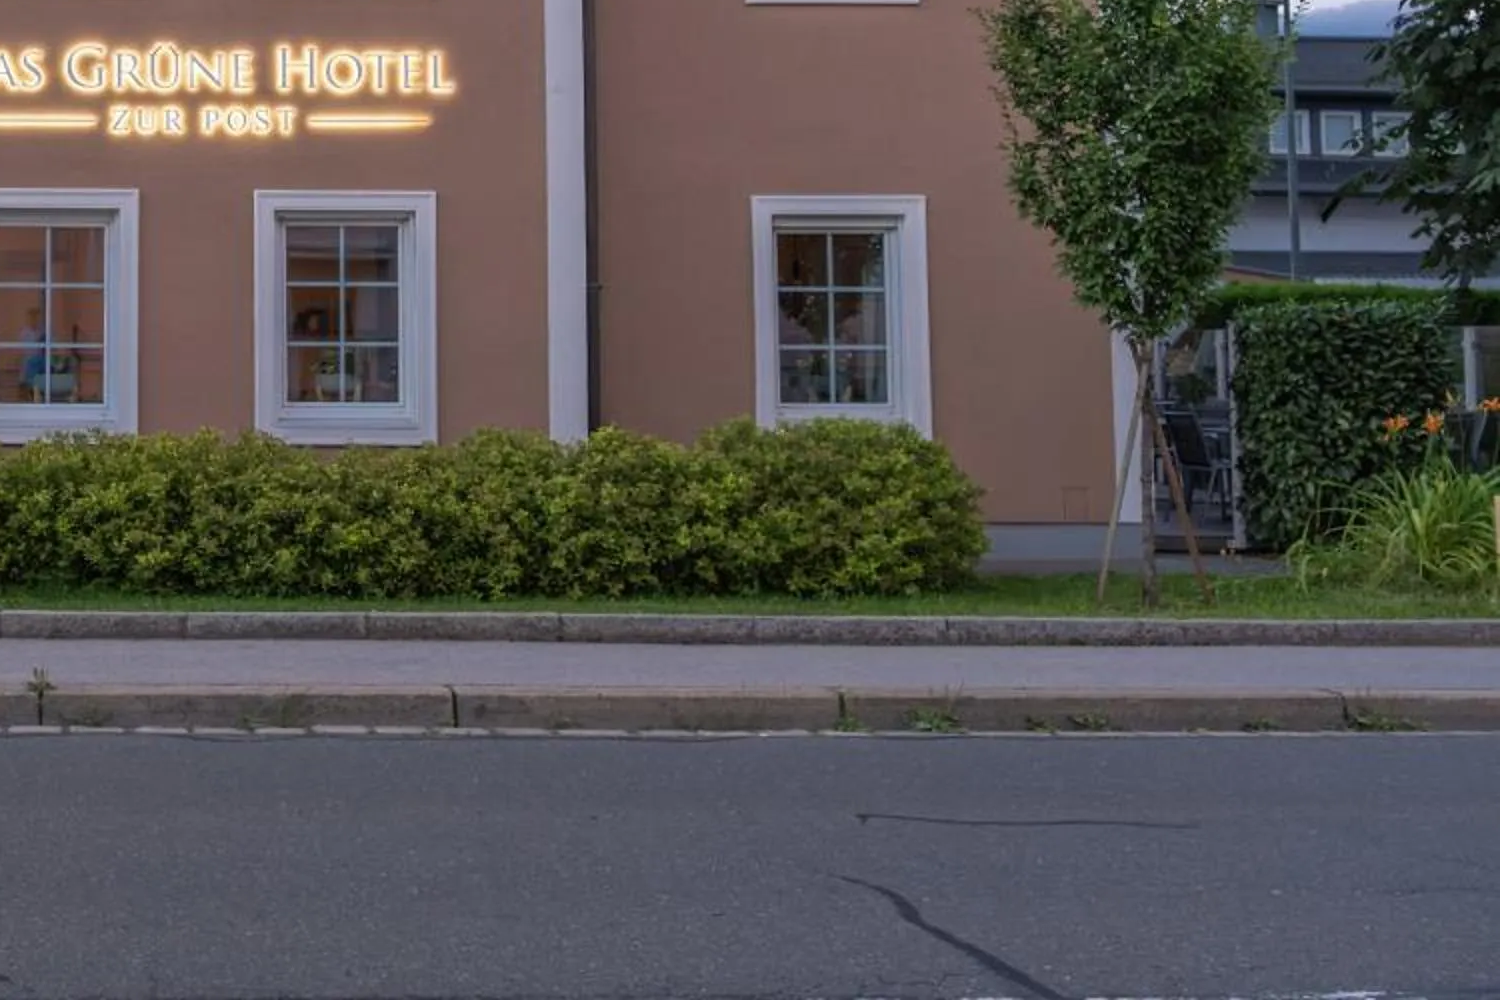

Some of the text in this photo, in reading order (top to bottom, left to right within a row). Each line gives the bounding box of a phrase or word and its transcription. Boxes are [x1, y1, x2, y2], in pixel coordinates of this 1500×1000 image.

[65, 43, 254, 90] GRÜNE
[279, 45, 455, 91] HOTEL
[111, 107, 297, 134] ZUR POST
